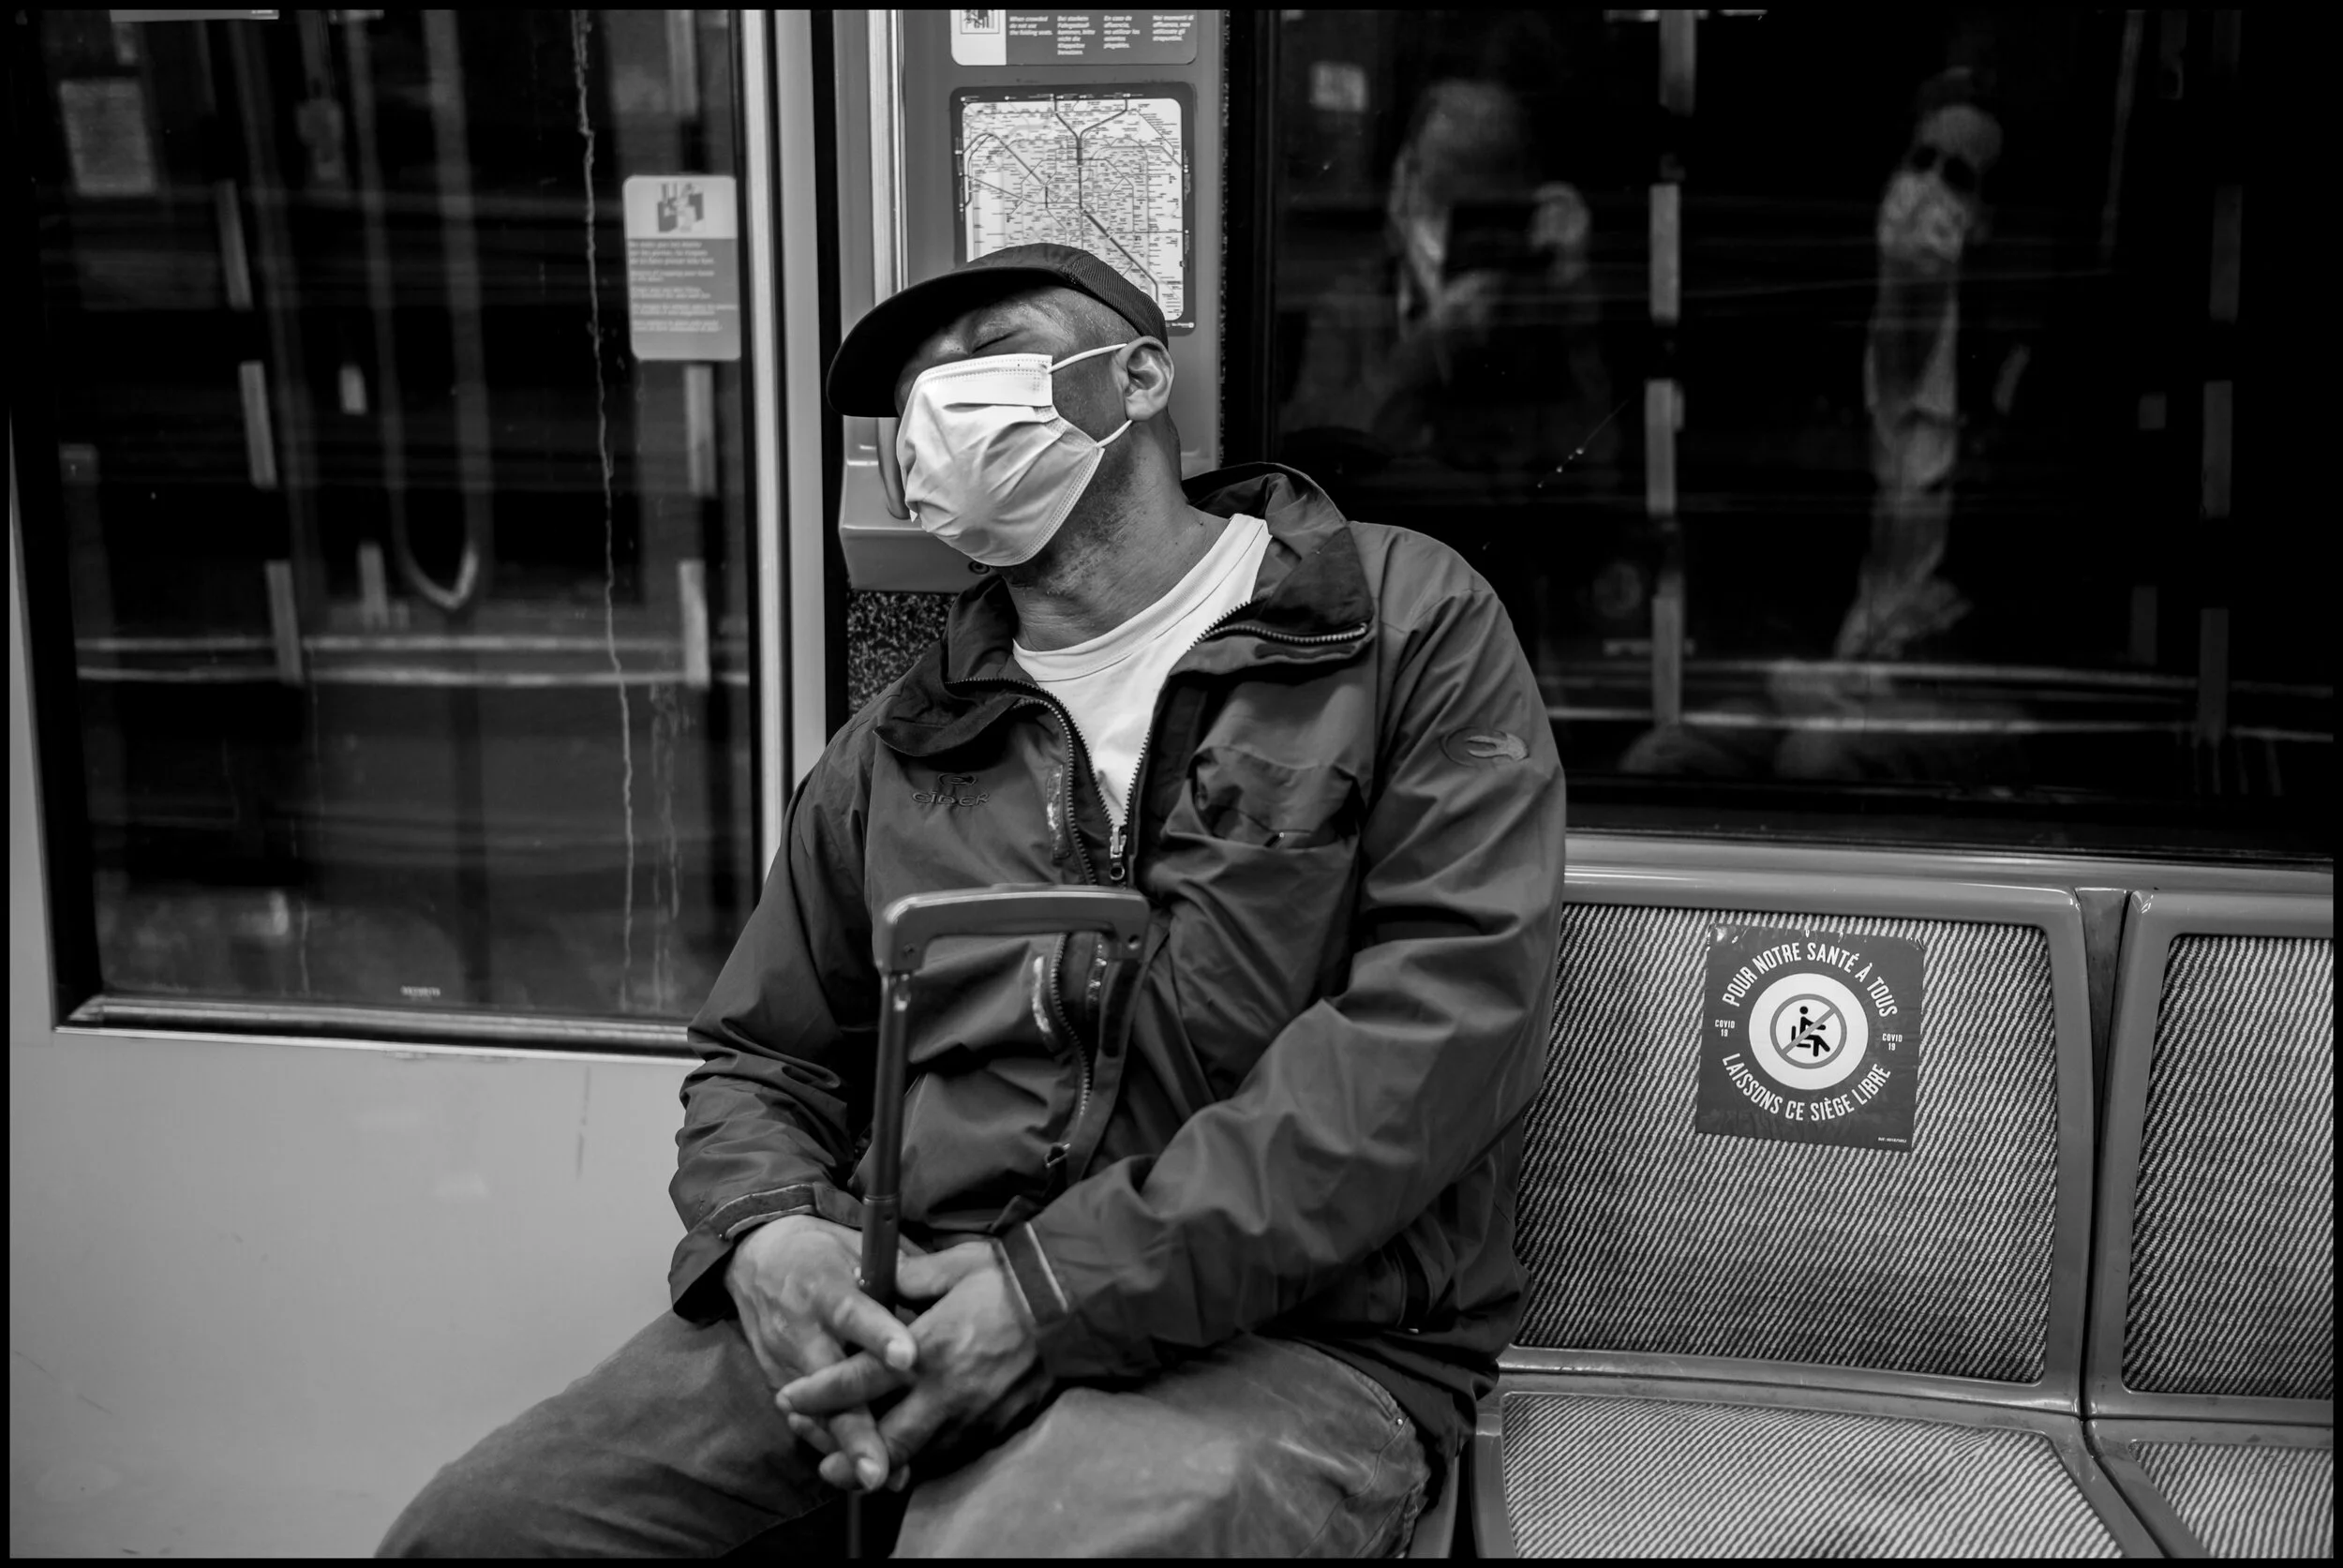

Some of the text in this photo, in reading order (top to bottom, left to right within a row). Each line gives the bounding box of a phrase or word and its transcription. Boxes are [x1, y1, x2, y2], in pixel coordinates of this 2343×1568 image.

[1722, 942, 1898, 1018] POUR NOTRE SANTÉ À TOUS
[1714, 1019, 1736, 1029] COVID
[1721, 1028, 1729, 1038] 19
[1882, 1033, 1903, 1043] COVID
[1888, 1042, 1896, 1052] 19
[1722, 1053, 1891, 1123] LAISSONS CE SIÈGE LIBRE
